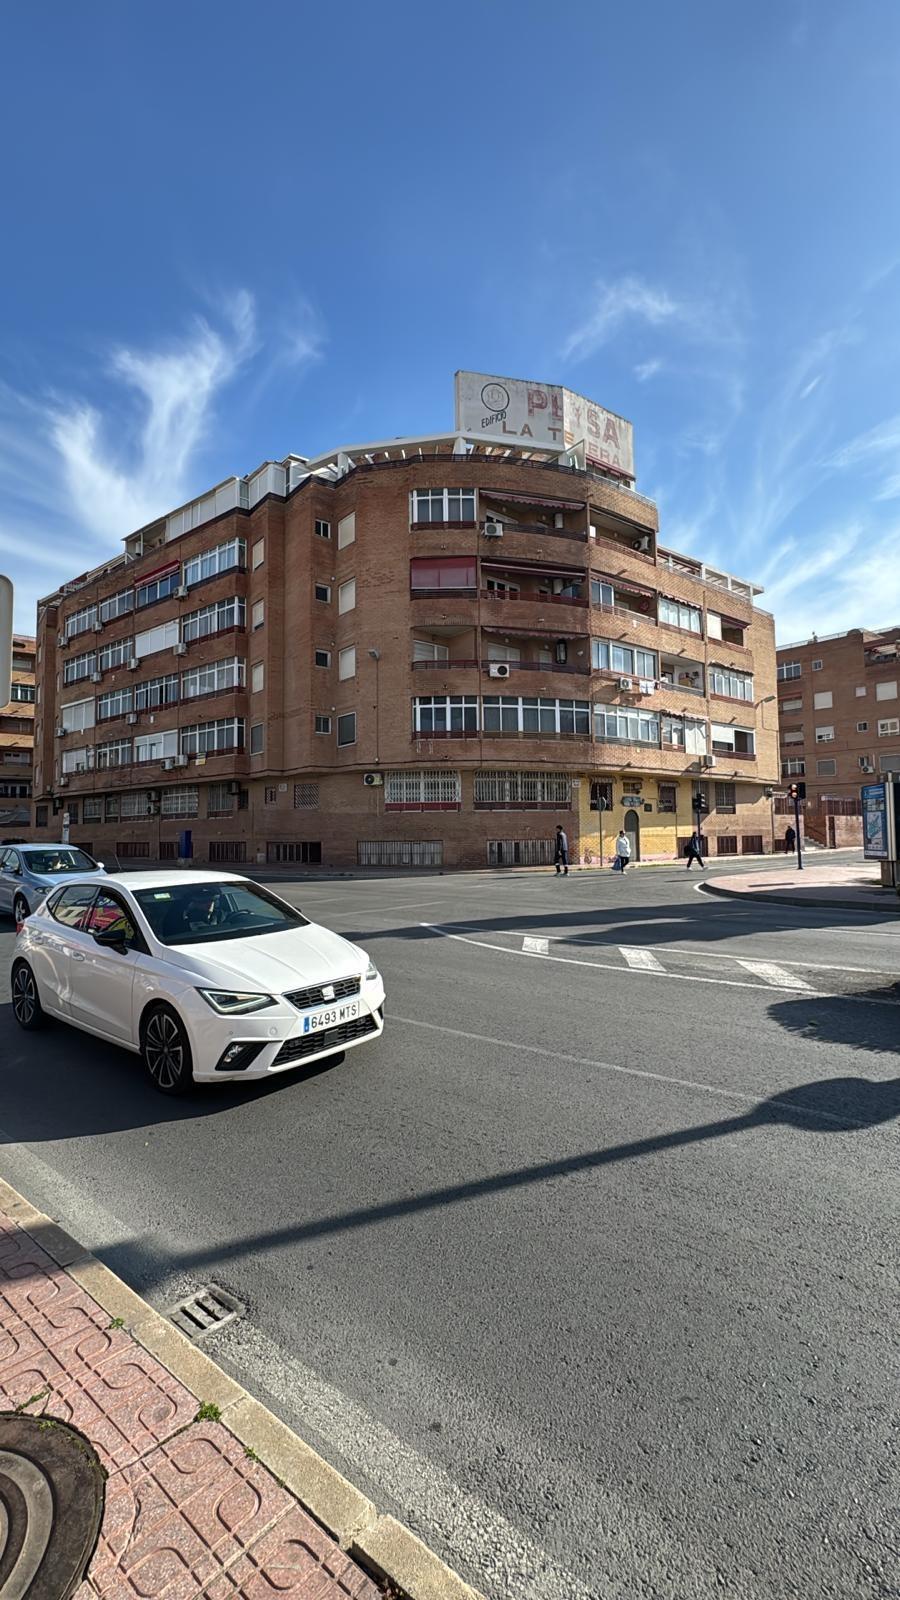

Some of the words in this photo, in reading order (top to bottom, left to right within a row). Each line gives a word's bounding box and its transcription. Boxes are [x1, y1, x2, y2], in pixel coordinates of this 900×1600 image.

[481, 410, 507, 429] EDIFICIO
[502, 420, 534, 438] LA
[547, 426, 620, 466] TEERA
[311, 1010, 337, 1029] 6493
[339, 1004, 357, 1020] MTS
